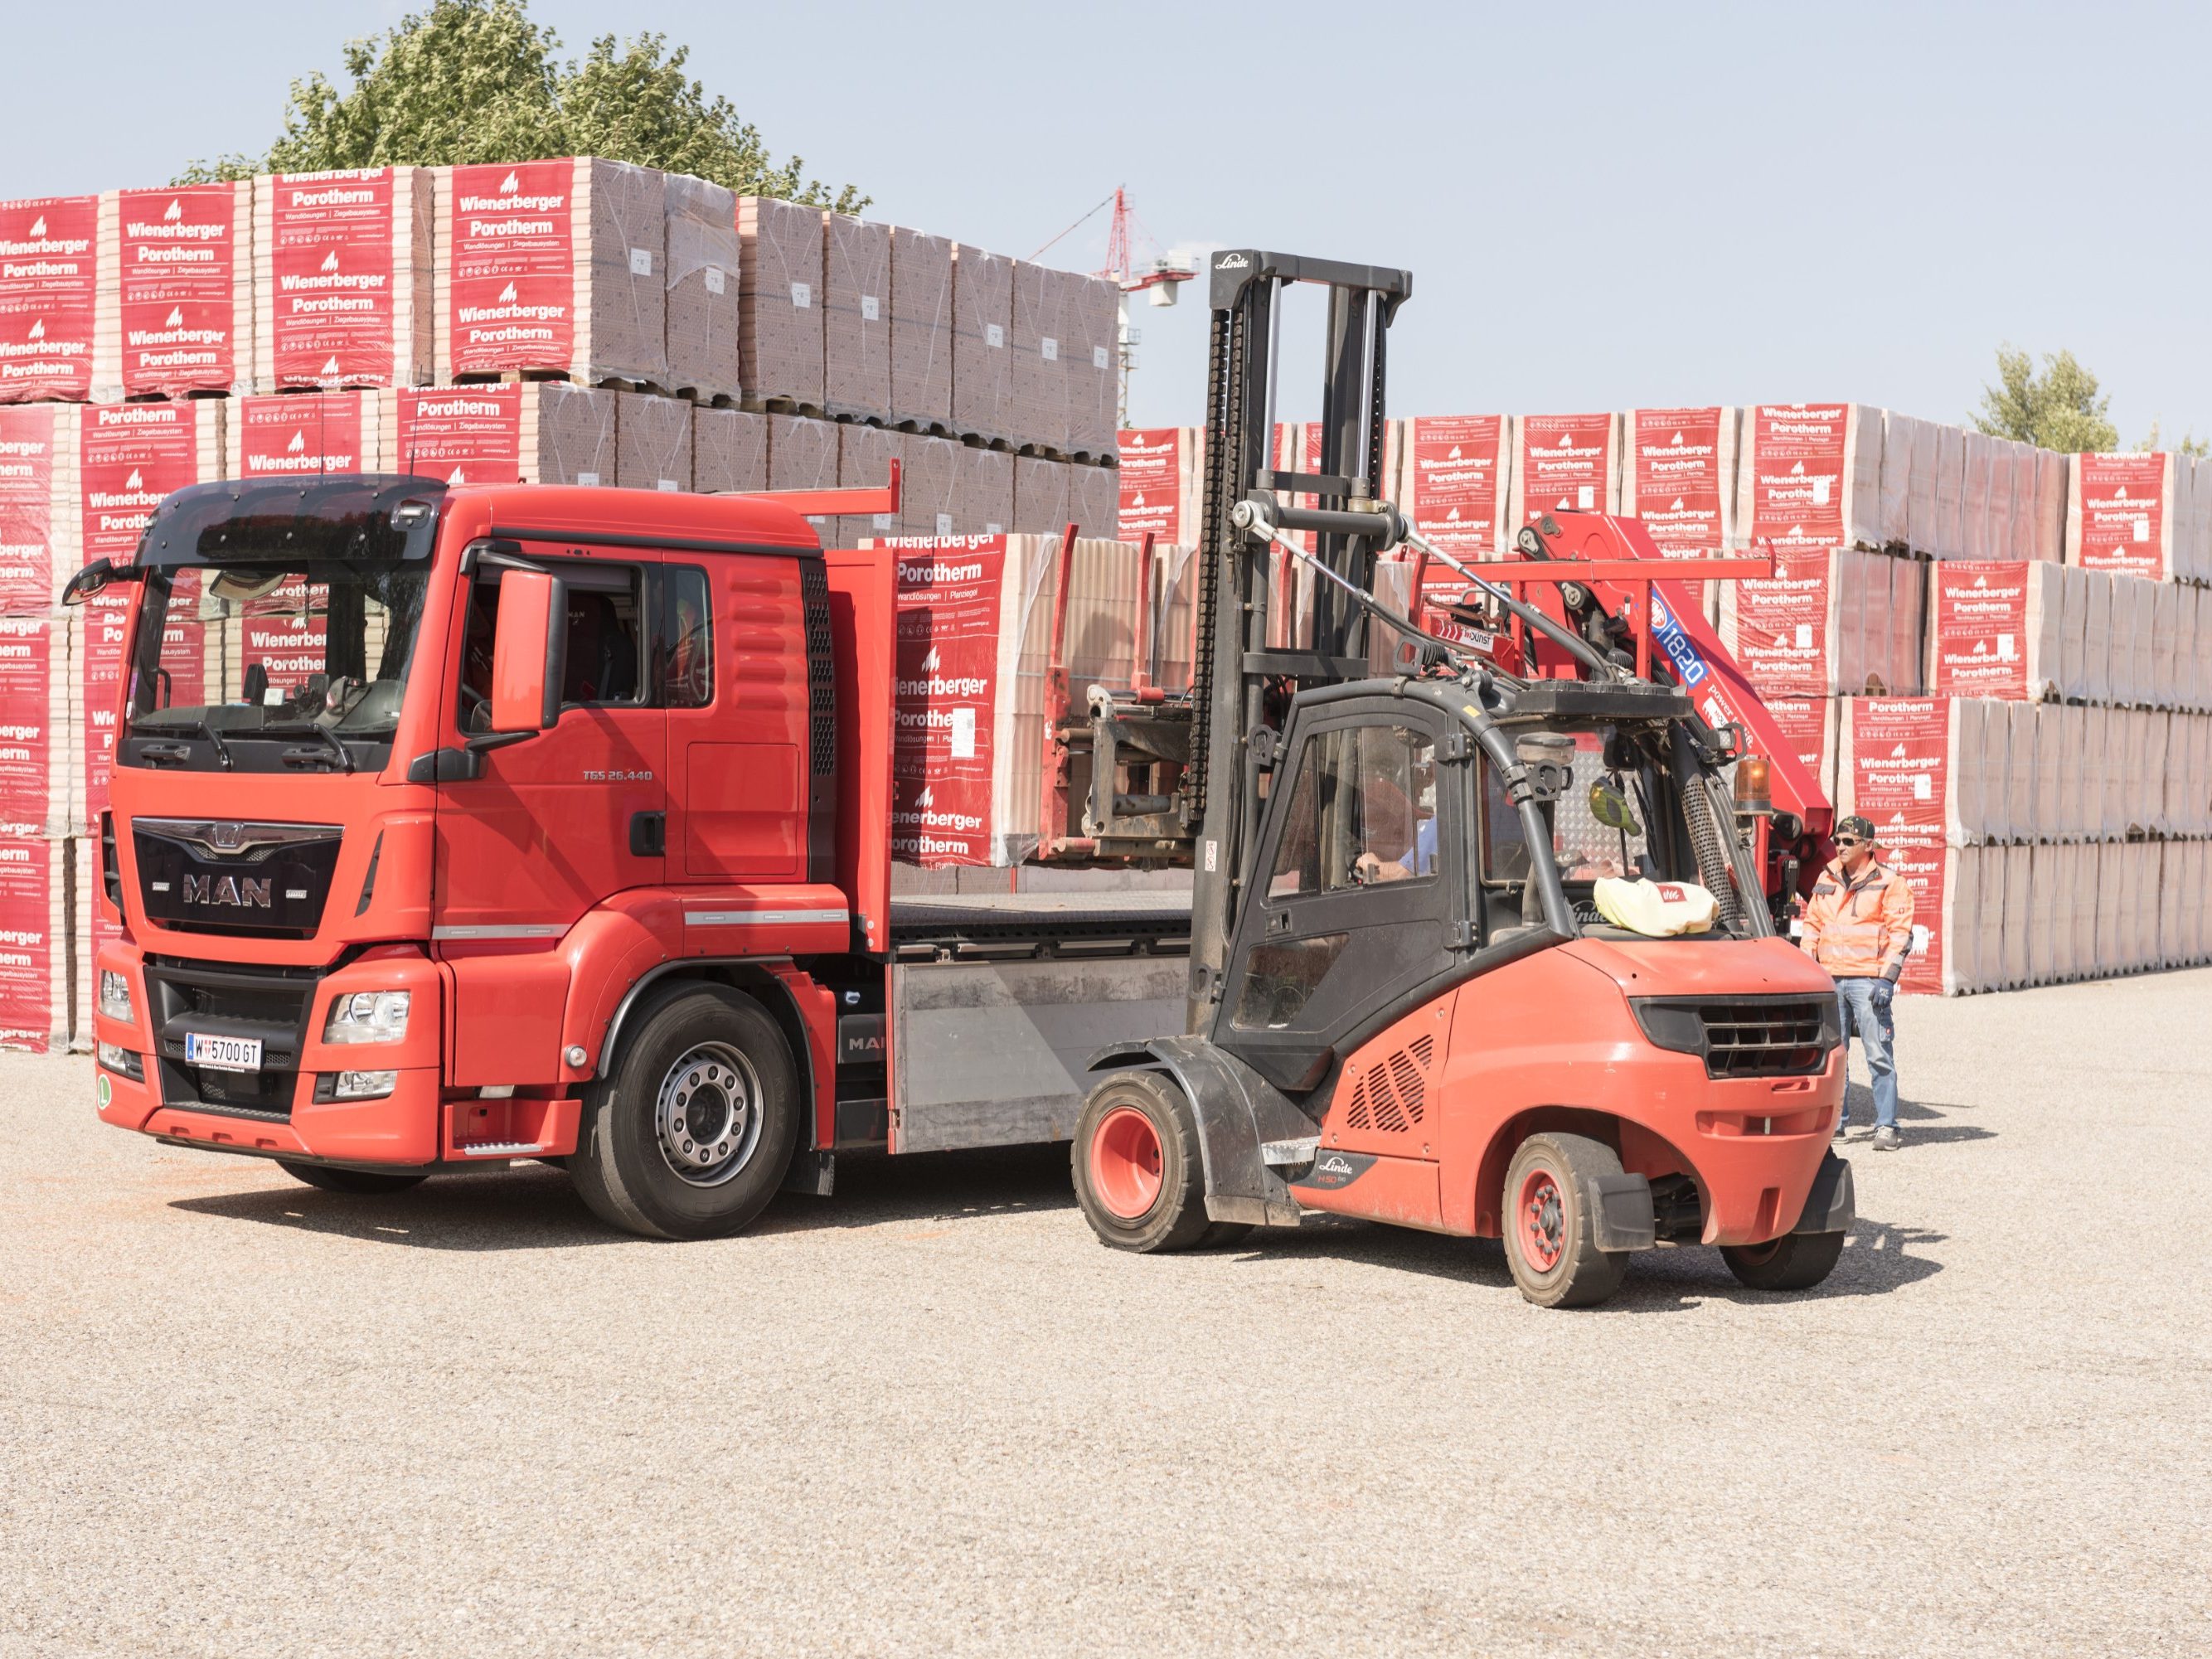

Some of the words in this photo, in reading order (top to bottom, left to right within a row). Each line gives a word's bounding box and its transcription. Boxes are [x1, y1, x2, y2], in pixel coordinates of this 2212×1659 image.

[293, 188, 374, 207] Porotherm
[459, 194, 564, 212] Wienerberger
[127, 223, 226, 240] Wienerberger
[470, 219, 552, 237] Porotherm
[138, 246, 214, 262] Porotherm
[1215, 253, 1249, 269] Linde
[3, 262, 78, 278] Porotherm
[280, 273, 386, 290] Wienerberger
[293, 297, 373, 313] Porotherm
[458, 303, 565, 323] Wienerberger
[129, 328, 226, 347] Wienerberger
[469, 327, 552, 343] Porotherm
[140, 351, 216, 367] Porotherm
[2, 362, 74, 378] Porotherm
[99, 408, 176, 424] Porotherm
[417, 399, 500, 417] Porotherm
[1762, 406, 1841, 420] Wienerberger
[1770, 421, 1831, 434] Porotherm
[1530, 447, 1602, 458] Wienerberger
[1642, 444, 1712, 457] Wienerberger
[249, 454, 352, 471] Wienerberger
[1537, 460, 1594, 471] Porotherm
[1651, 460, 1705, 472] Porotherm
[89, 491, 170, 508] Wienerber
[1768, 488, 1813, 499] Porothe
[1641, 510, 1715, 521] Wienerberger
[1757, 536, 1838, 546] Wenerberger
[898, 562, 982, 582] Porotherm
[1741, 578, 1822, 591] Wienerberger
[1945, 586, 2020, 598] Wienerberger
[950, 588, 977, 599] Planziegel
[1751, 593, 1813, 605] Porotherm
[1953, 602, 2011, 613] Porotherm
[1663, 628, 1704, 684] 1820
[1752, 661, 1812, 672] Porotherm
[1952, 667, 2012, 677] Porotherm
[895, 674, 987, 697] ienerberger
[1707, 684, 1734, 716] power
[1869, 701, 1933, 713] Porotherm
[895, 709, 953, 727] Porothe
[1860, 756, 1941, 769] Wienerberger
[583, 770, 605, 781] TGS
[608, 770, 652, 781] 26.440
[893, 810, 982, 831] enerberger
[892, 836, 968, 854] orotherm
[183, 874, 272, 909] MAN
[196, 1039, 203, 1058] W
[212, 1041, 240, 1062] 5700
[244, 1044, 257, 1064] GT
[1318, 1157, 1353, 1175] Linde
